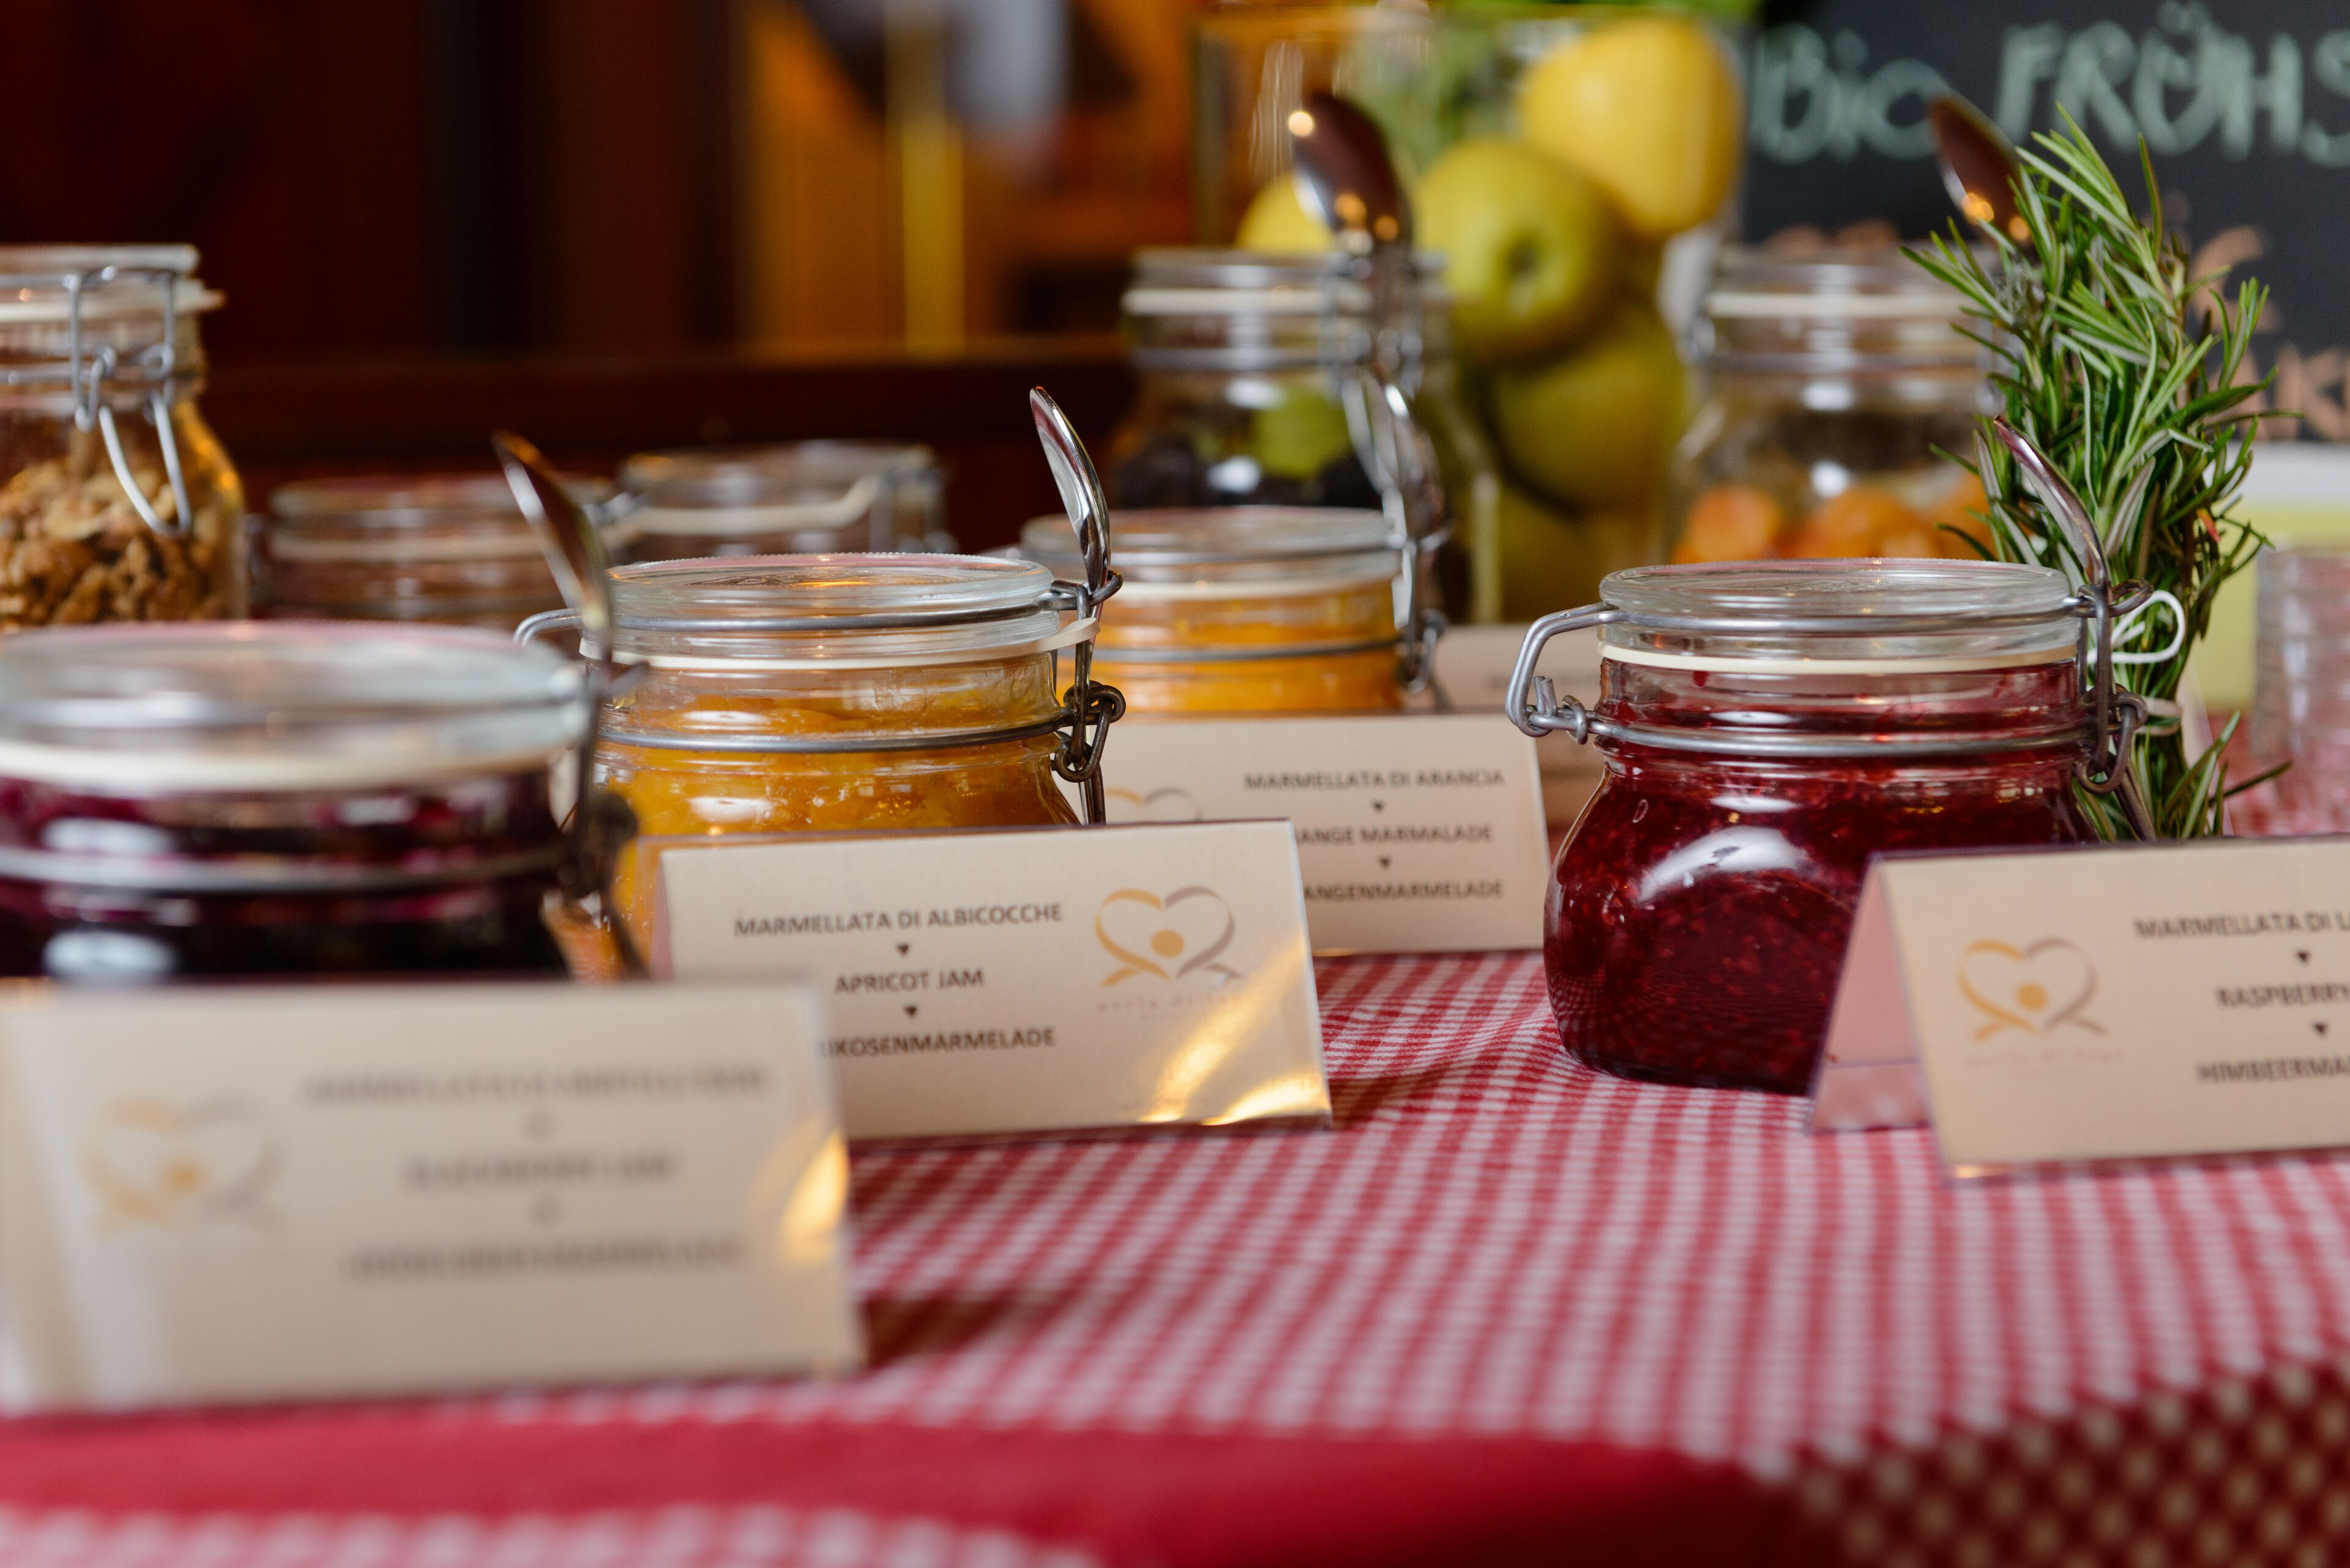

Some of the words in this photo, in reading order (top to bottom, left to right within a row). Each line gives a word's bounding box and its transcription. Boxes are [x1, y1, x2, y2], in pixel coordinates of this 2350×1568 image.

[1244, 771, 1386, 790] MARMELLATA
[1390, 771, 1409, 786] DI
[1417, 769, 1505, 786] ARANCIA
[1294, 827, 1354, 845] ANGE
[1360, 824, 1492, 843] MARMALADE
[1302, 879, 1503, 901] ANGENMARMELADE
[735, 913, 891, 937] MARMELLATA
[898, 912, 920, 929] DI
[927, 903, 1062, 928] ALBICOCCHE
[2135, 913, 2304, 938] MARMELLATA
[2305, 912, 2330, 932] DI
[835, 971, 928, 995] APRICOT
[939, 969, 984, 990] JAM
[2198, 1057, 2350, 1081] HIMBEERMA
